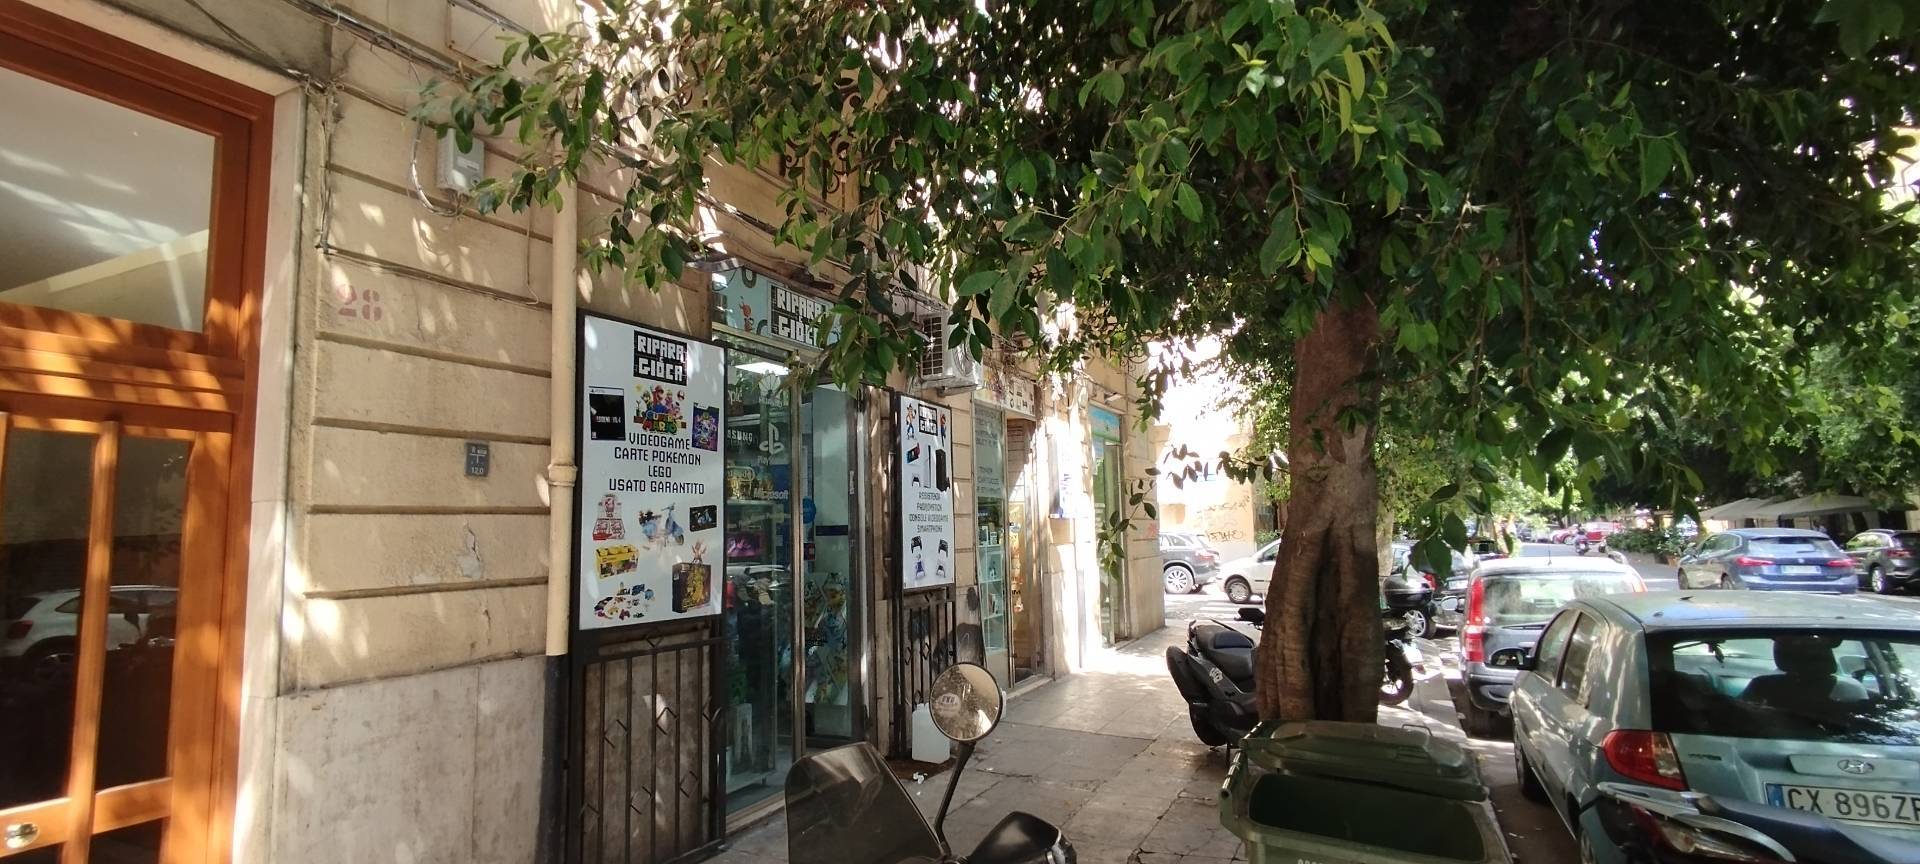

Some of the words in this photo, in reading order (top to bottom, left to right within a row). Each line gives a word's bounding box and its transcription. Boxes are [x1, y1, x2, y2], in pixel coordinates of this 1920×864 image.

[336, 285, 382, 321] 28
[637, 334, 686, 362] RIPARA
[638, 357, 683, 382] GIOCA
[629, 432, 690, 450] VIDEOGAME
[614, 447, 648, 462] CARTE
[652, 450, 701, 466] POKEMON
[648, 465, 672, 477] LEGO
[609, 478, 646, 492] USATO
[650, 481, 705, 495] GARANTITO
[1787, 788, 1824, 814] CX
